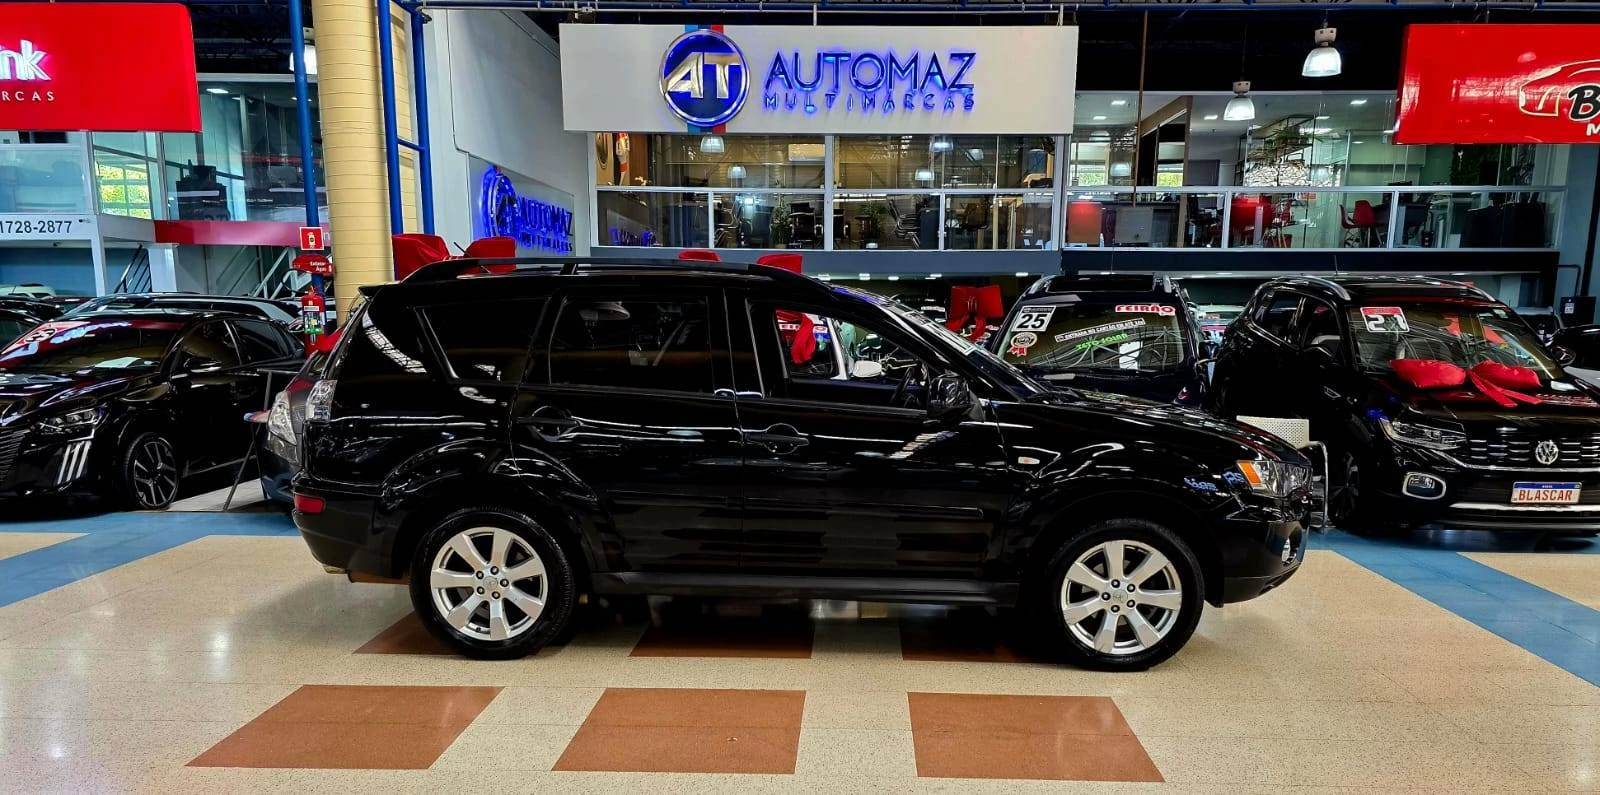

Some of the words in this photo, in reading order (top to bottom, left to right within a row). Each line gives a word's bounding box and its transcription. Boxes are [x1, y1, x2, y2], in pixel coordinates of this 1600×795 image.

[765, 51, 976, 91] AUTOMAZ
[764, 92, 974, 111] MULTIMARCAS
[0, 220, 72, 233] 1728-2877
[1115, 304, 1174, 313] FEIRÃO
[1016, 313, 1047, 329] 25
[1367, 314, 1406, 331] 21
[1518, 489, 1573, 501] BLASCAR
